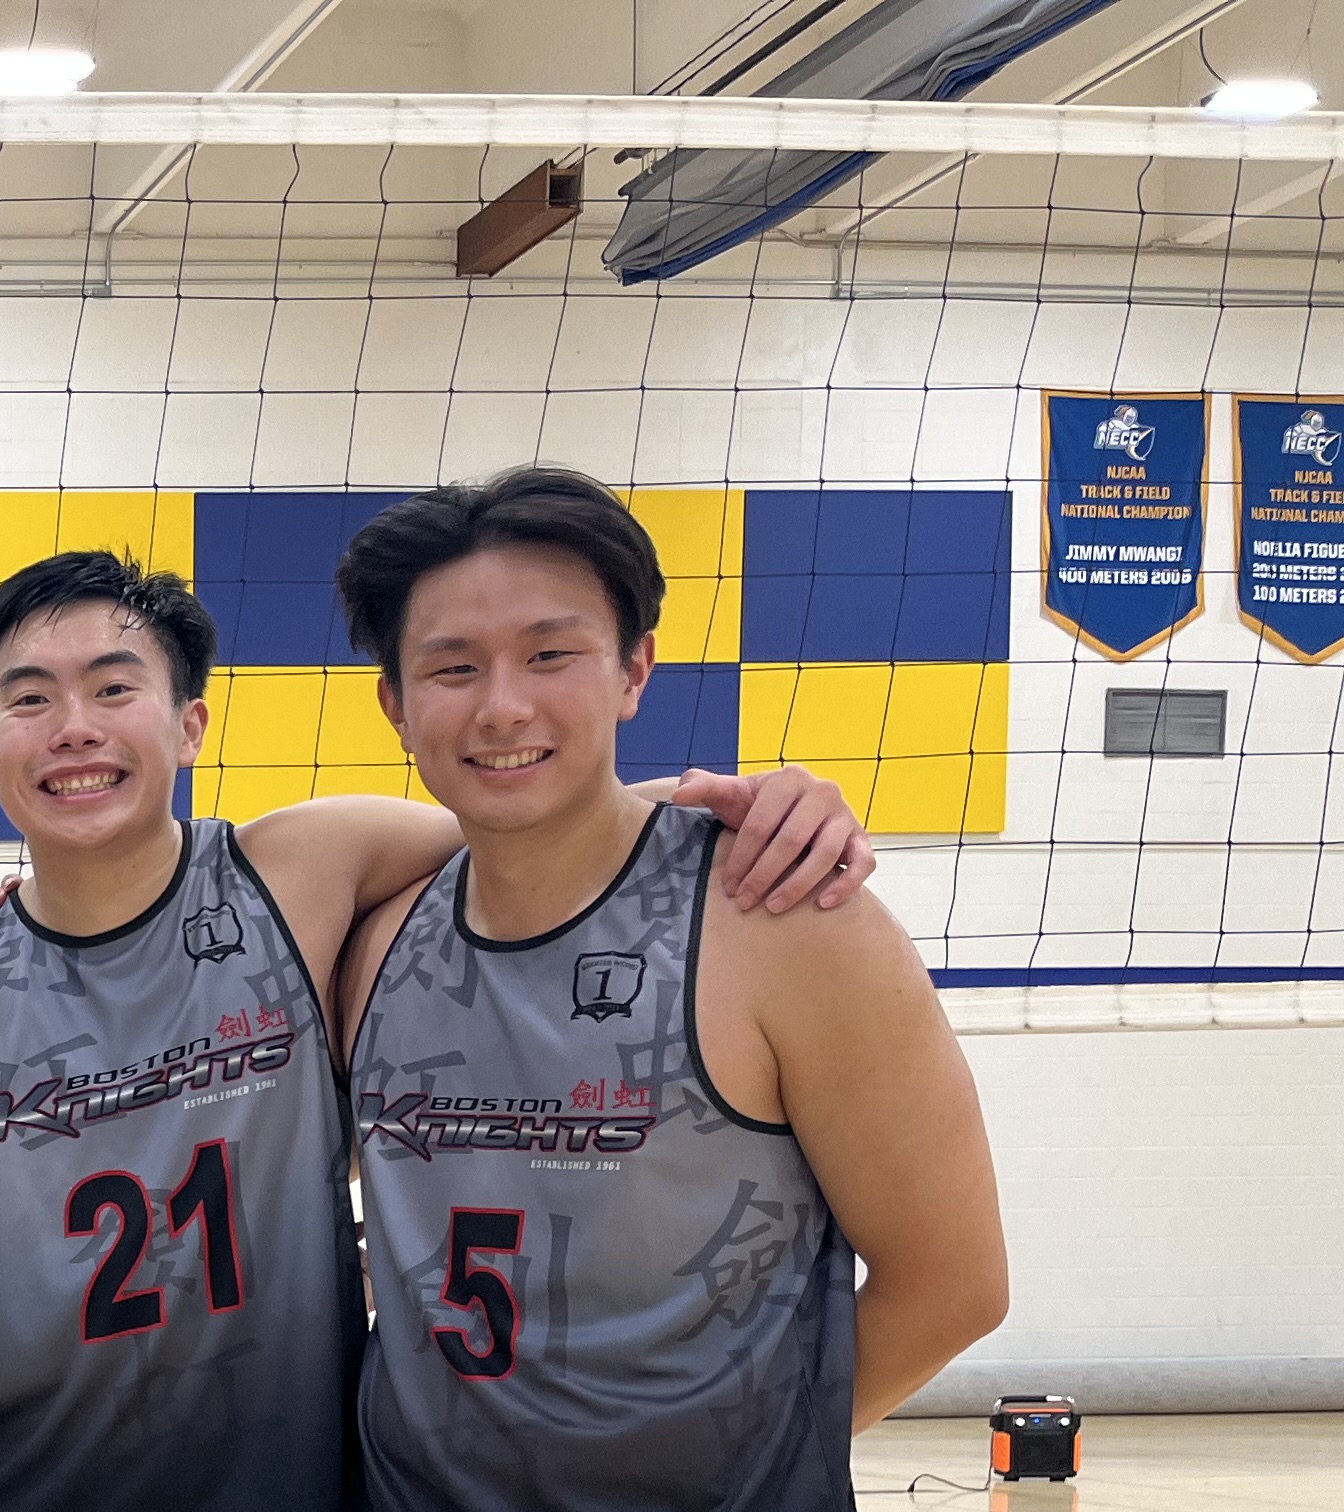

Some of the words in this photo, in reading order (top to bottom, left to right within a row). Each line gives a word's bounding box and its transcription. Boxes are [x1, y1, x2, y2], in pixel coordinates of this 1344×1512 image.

[1107, 466, 1146, 480] NJCAA
[1294, 470, 1333, 485] NJCAA
[1080, 485, 1122, 499] TRACK
[1135, 486, 1171, 500] FIELD
[1269, 488, 1309, 503] TRACK
[1323, 490, 1344, 504] FIE
[1061, 503, 1120, 519] NATIONAL
[1123, 505, 1192, 520] CHAMPION
[1251, 507, 1308, 522] NATIONAL
[1065, 544, 1117, 561] JIMMY
[1119, 546, 1183, 562] MWANGI
[1090, 567, 1149, 585] METERS
[1279, 564, 1337, 581] METERS
[1252, 585, 1277, 602] 100
[1279, 587, 1337, 604] METERS
[593, 968, 612, 1000] 1
[66, 1037, 211, 1091] BOSTON
[183, 1085, 250, 1110] ESTABLISHED
[430, 1097, 562, 1113] BOSTON
[530, 1160, 591, 1170] ESTABLISHED
[596, 1161, 621, 1171] 1961
[64, 1137, 244, 1345] 21
[431, 1206, 525, 1381] 5
